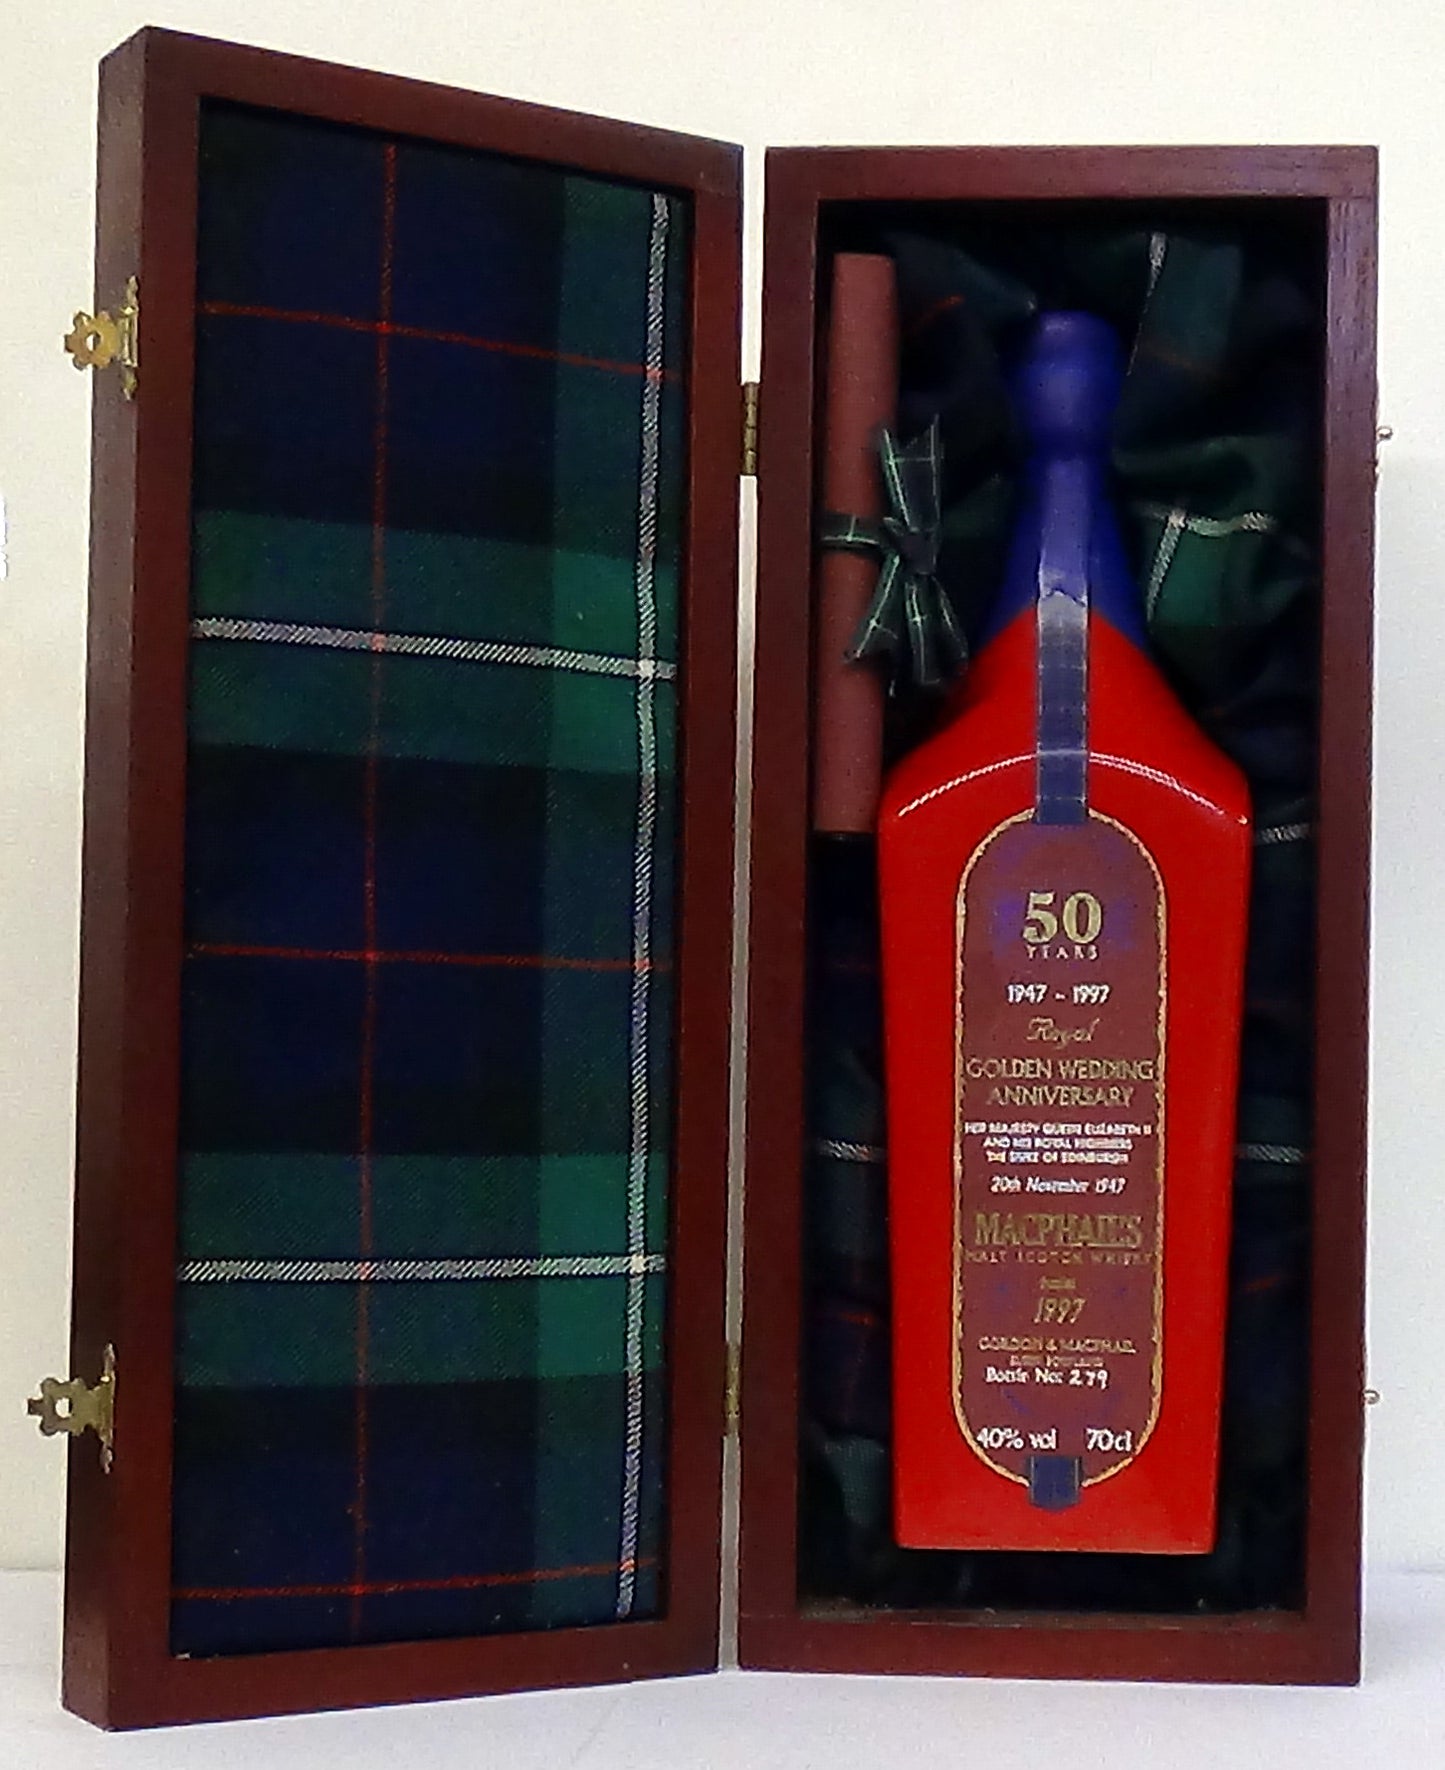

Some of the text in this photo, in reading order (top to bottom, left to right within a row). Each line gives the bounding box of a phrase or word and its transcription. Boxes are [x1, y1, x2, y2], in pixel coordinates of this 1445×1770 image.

[1023, 892, 1101, 943] 50
[1027, 945, 1097, 959] YEARS
[1008, 984, 1047, 1003] 1947
[1073, 984, 1110, 1003] 1997
[1026, 1016, 1101, 1049] Royal
[966, 1058, 1154, 1080] GOLDEN WEDDING
[986, 1085, 1134, 1107] ANNIVERSARY
[990, 1176, 1022, 1192] 20th
[1025, 1177, 1089, 1193] November
[1032, 1297, 1087, 1324] 1997
[1068, 1369, 1109, 1390] 279
[976, 1428, 1133, 1451] 40% vol 70cl
